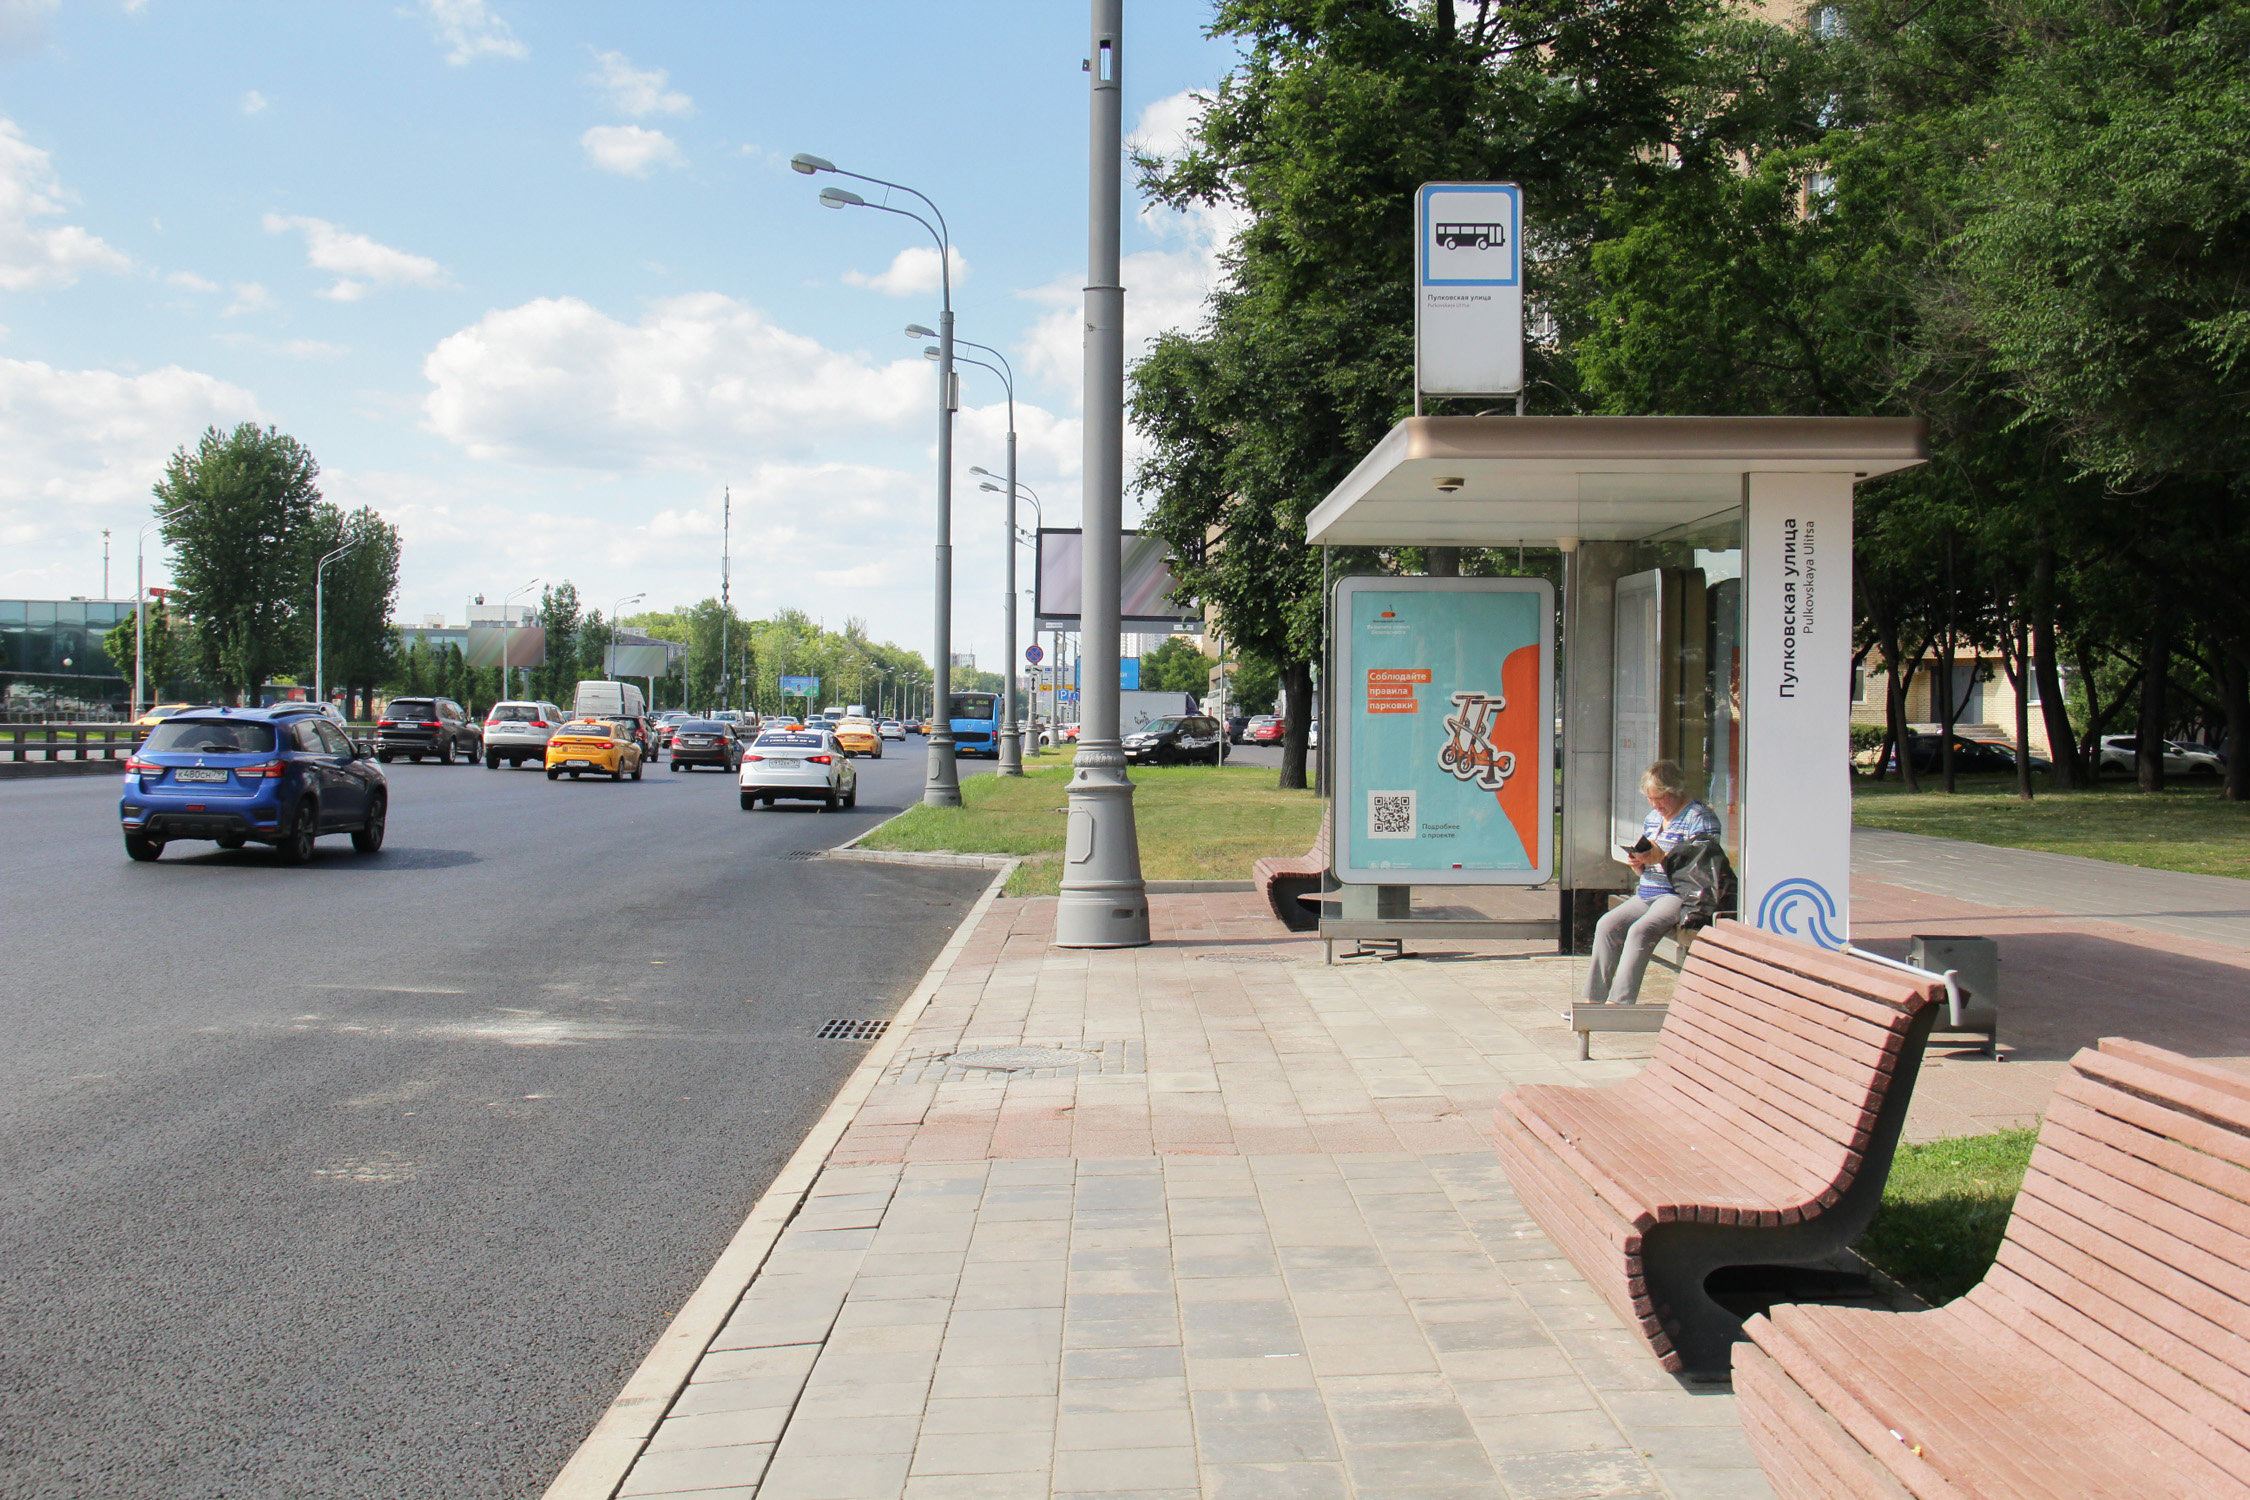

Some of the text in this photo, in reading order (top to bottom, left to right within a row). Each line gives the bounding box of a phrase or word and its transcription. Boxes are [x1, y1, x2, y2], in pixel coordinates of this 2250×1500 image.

[1427, 294, 1469, 302] Пулковская
[1803, 521, 1816, 634] Pulkovskaya Ulitsa
[1780, 518, 1800, 697] Пулковская улица
[1369, 671, 1427, 682] Соблюдайте
[1369, 688, 1408, 696] правила
[1369, 702, 1414, 711] парковки
